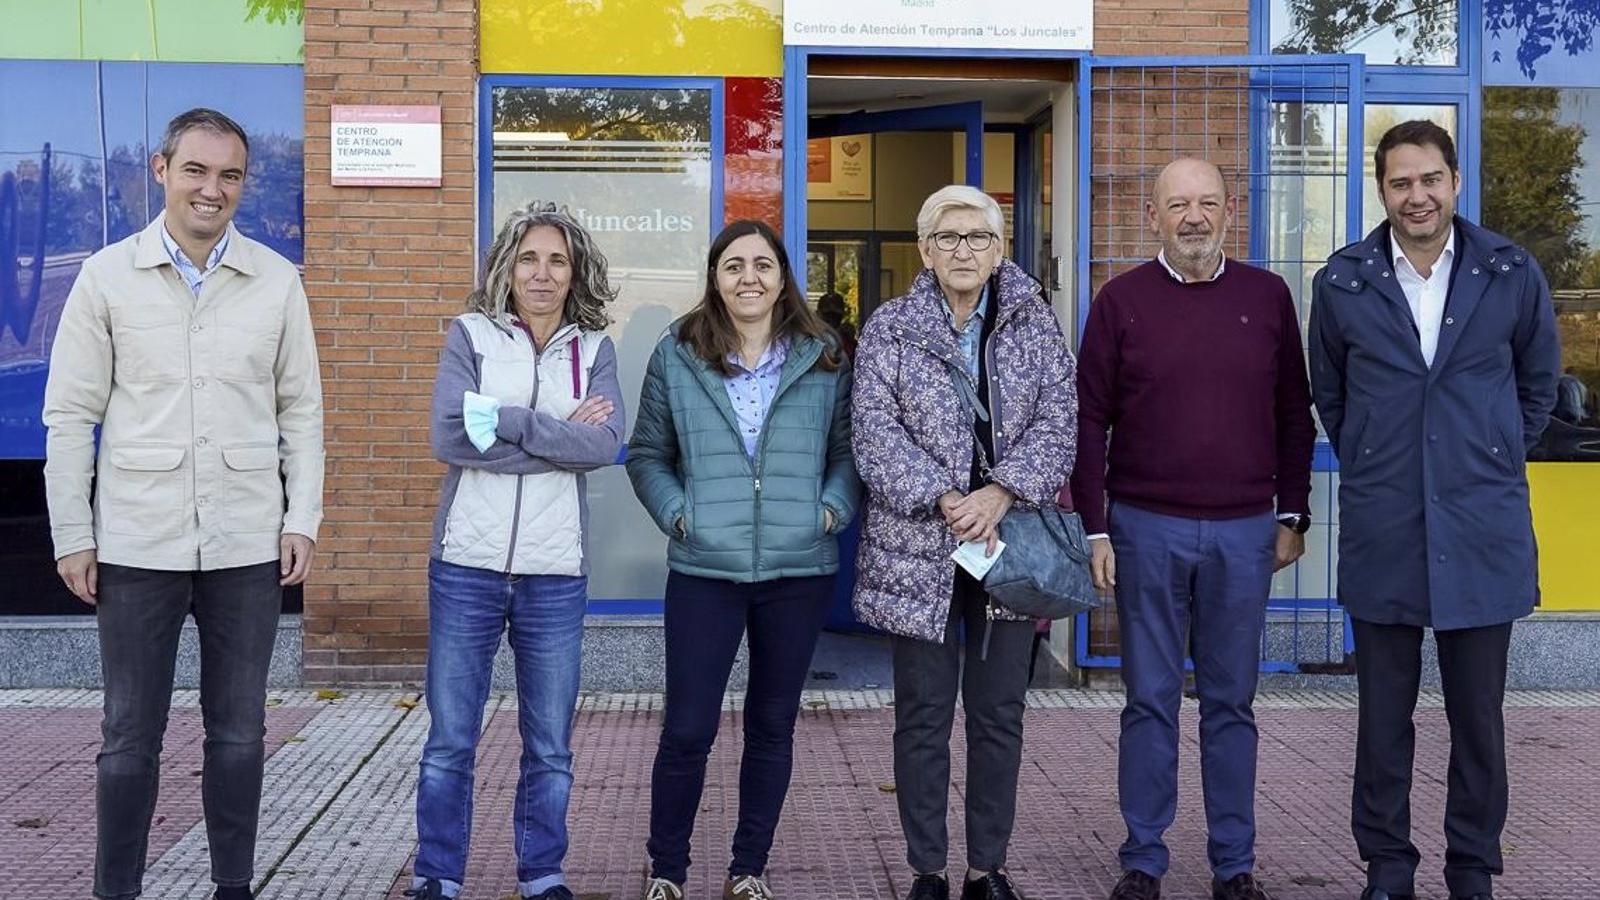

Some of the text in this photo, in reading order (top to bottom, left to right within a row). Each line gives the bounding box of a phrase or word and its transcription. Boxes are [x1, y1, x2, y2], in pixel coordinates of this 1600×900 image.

[793, 22, 837, 34] Centro
[840, 23, 856, 35] de
[860, 23, 917, 36] Atención
[920, 24, 984, 38] Temprana
[336, 126, 378, 136] CENTRO
[336, 137, 350, 146] DE
[337, 148, 392, 157] TEMPRANA
